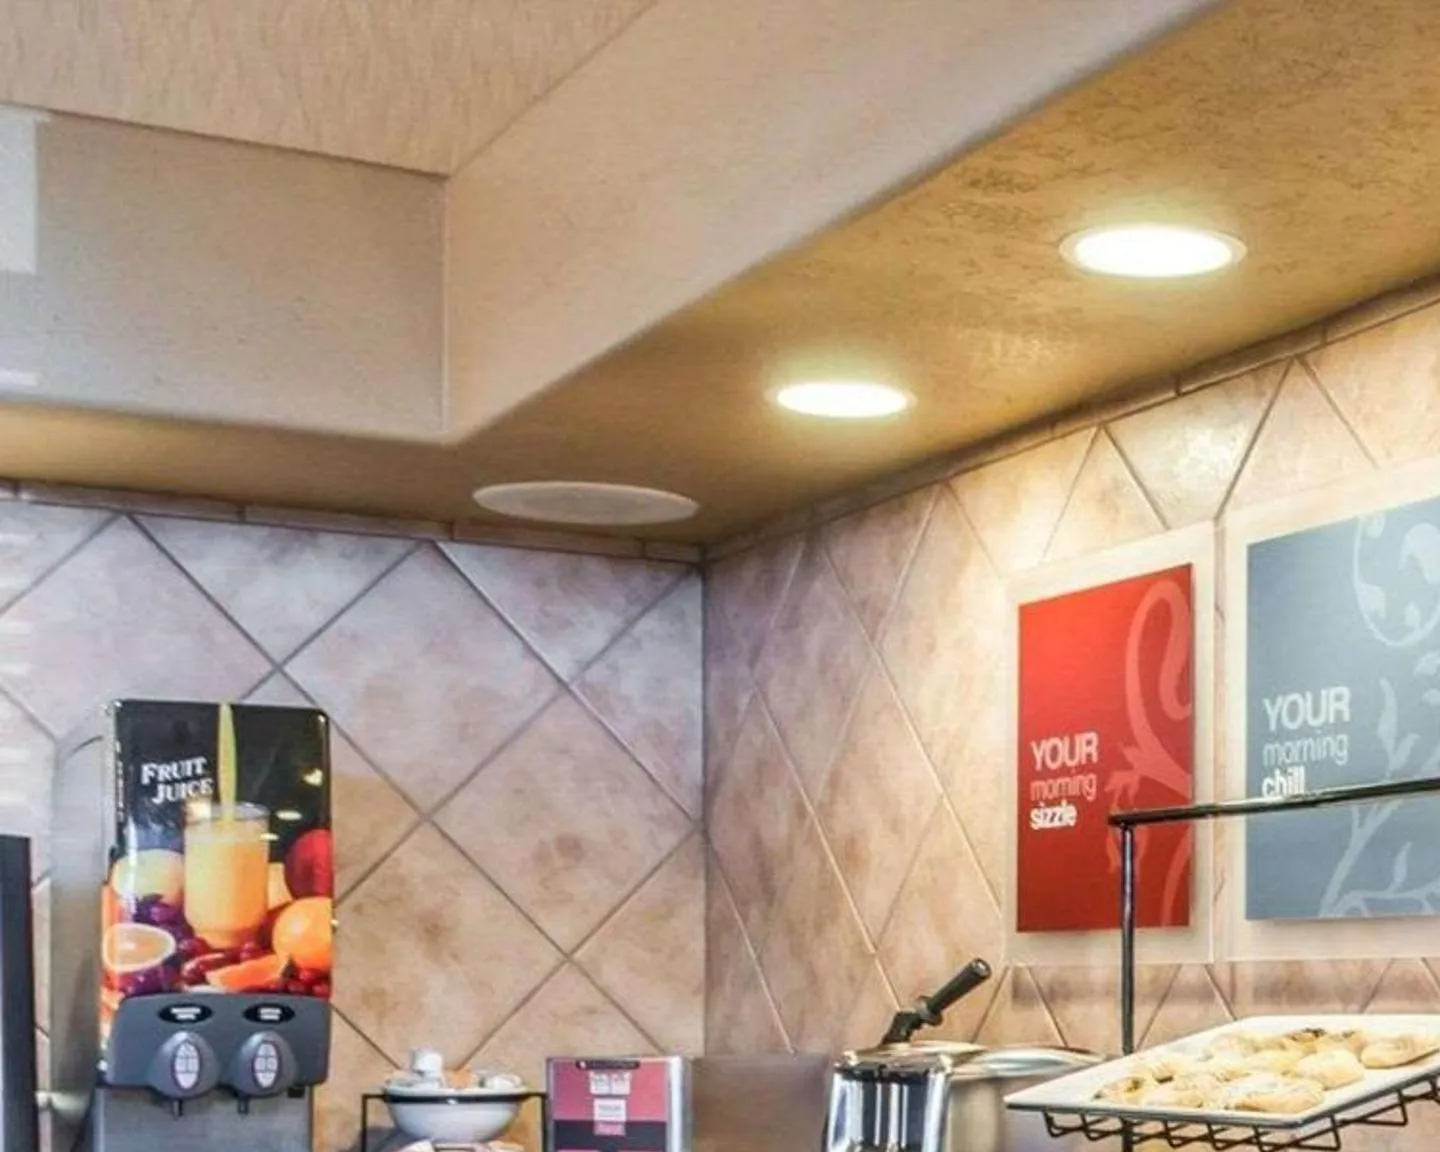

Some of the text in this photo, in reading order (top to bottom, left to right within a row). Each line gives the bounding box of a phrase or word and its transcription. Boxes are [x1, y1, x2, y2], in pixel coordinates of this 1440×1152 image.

[1262, 686, 1351, 732] YOUR
[1030, 731, 1099, 772] YOUR
[1262, 729, 1349, 767] morning
[141, 756, 208, 785] FRUIT
[1030, 767, 1097, 802] morning
[1262, 765, 1306, 799] chill
[152, 778, 214, 805] JUICE
[1030, 799, 1078, 831] sizzle
